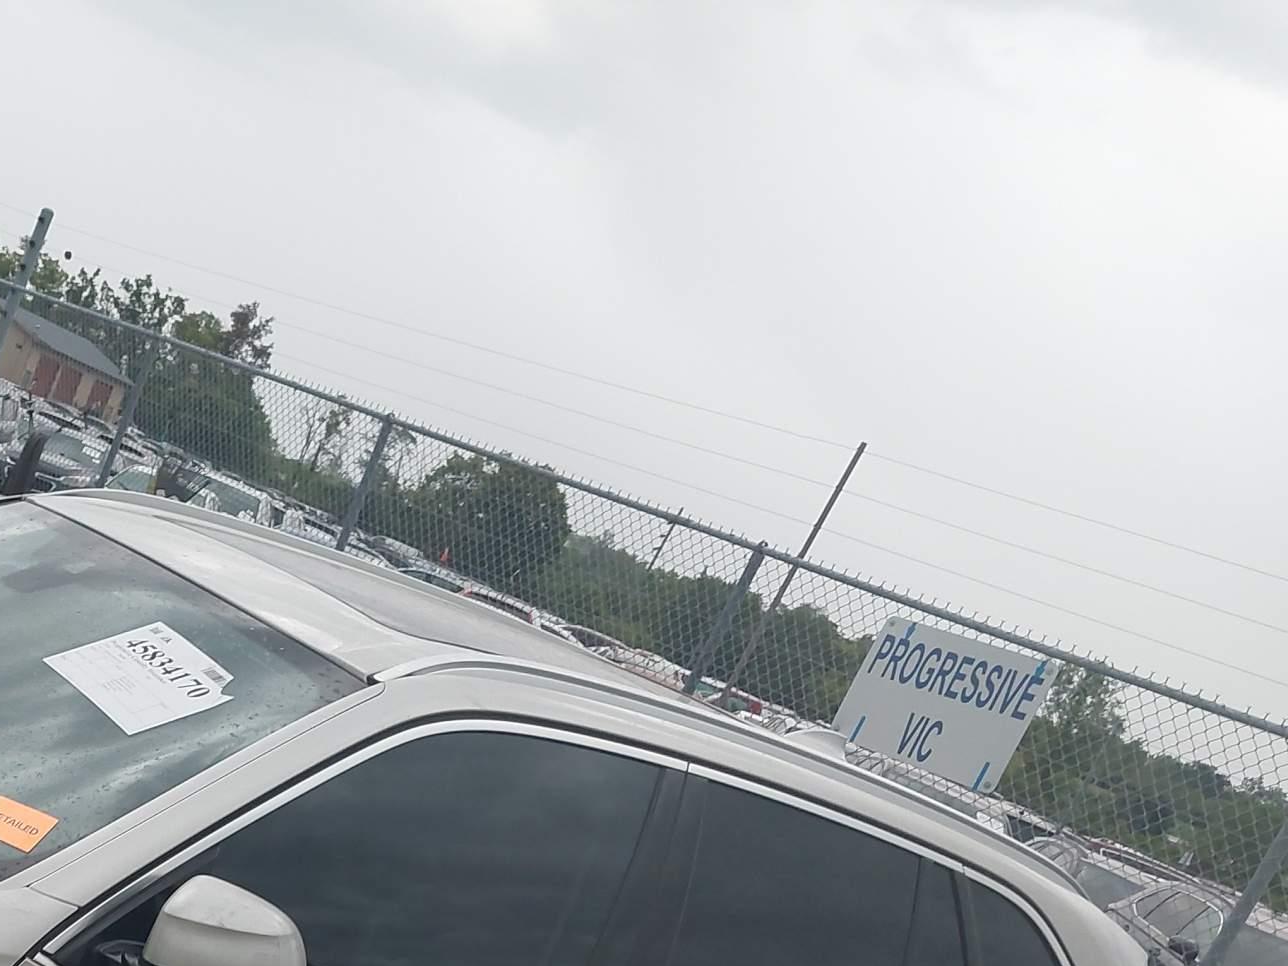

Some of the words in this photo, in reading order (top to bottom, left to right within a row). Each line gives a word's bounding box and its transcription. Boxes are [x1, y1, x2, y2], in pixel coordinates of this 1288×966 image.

[126, 638, 211, 698] 45834170
[867, 633, 1045, 721] PROGRESSIVE
[896, 712, 943, 763] VIC
